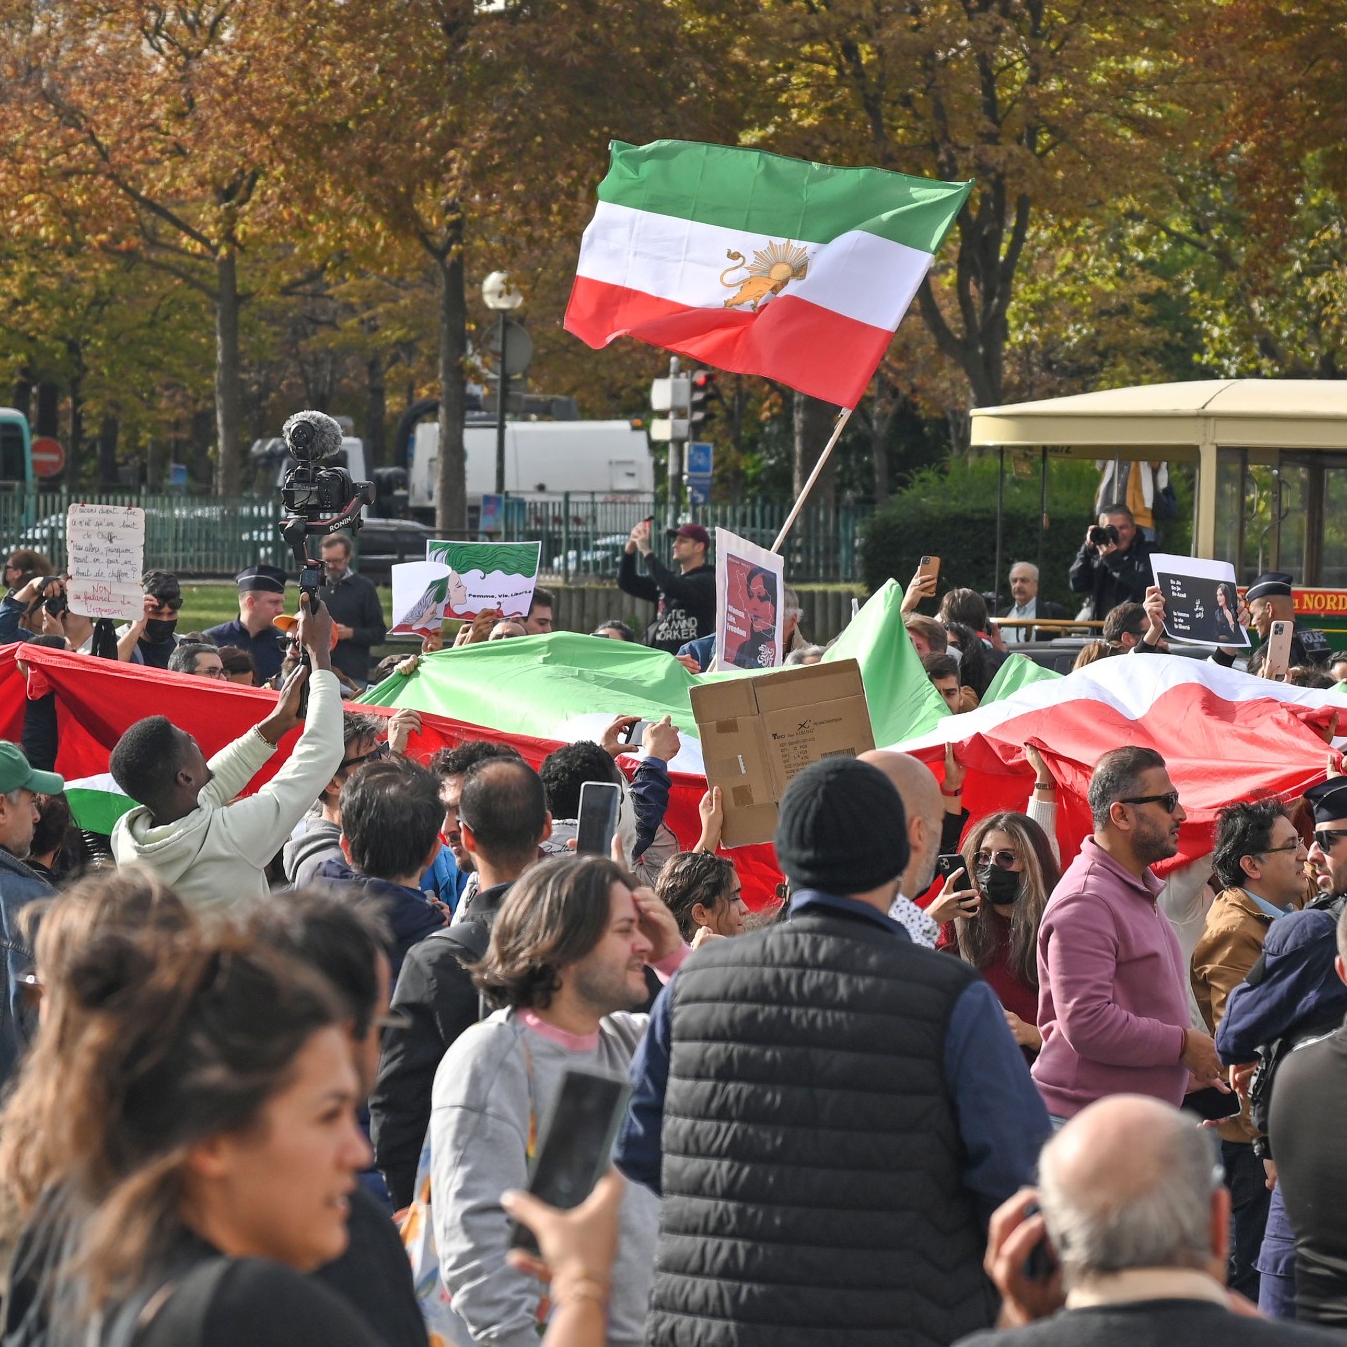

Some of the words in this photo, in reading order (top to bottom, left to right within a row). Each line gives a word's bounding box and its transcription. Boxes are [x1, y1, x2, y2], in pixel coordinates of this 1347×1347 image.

[329, 515, 352, 532] RONIN
[92, 581, 113, 595] NON
[726, 623, 747, 638] Freedom
[1301, 632, 1327, 644] POLICE
